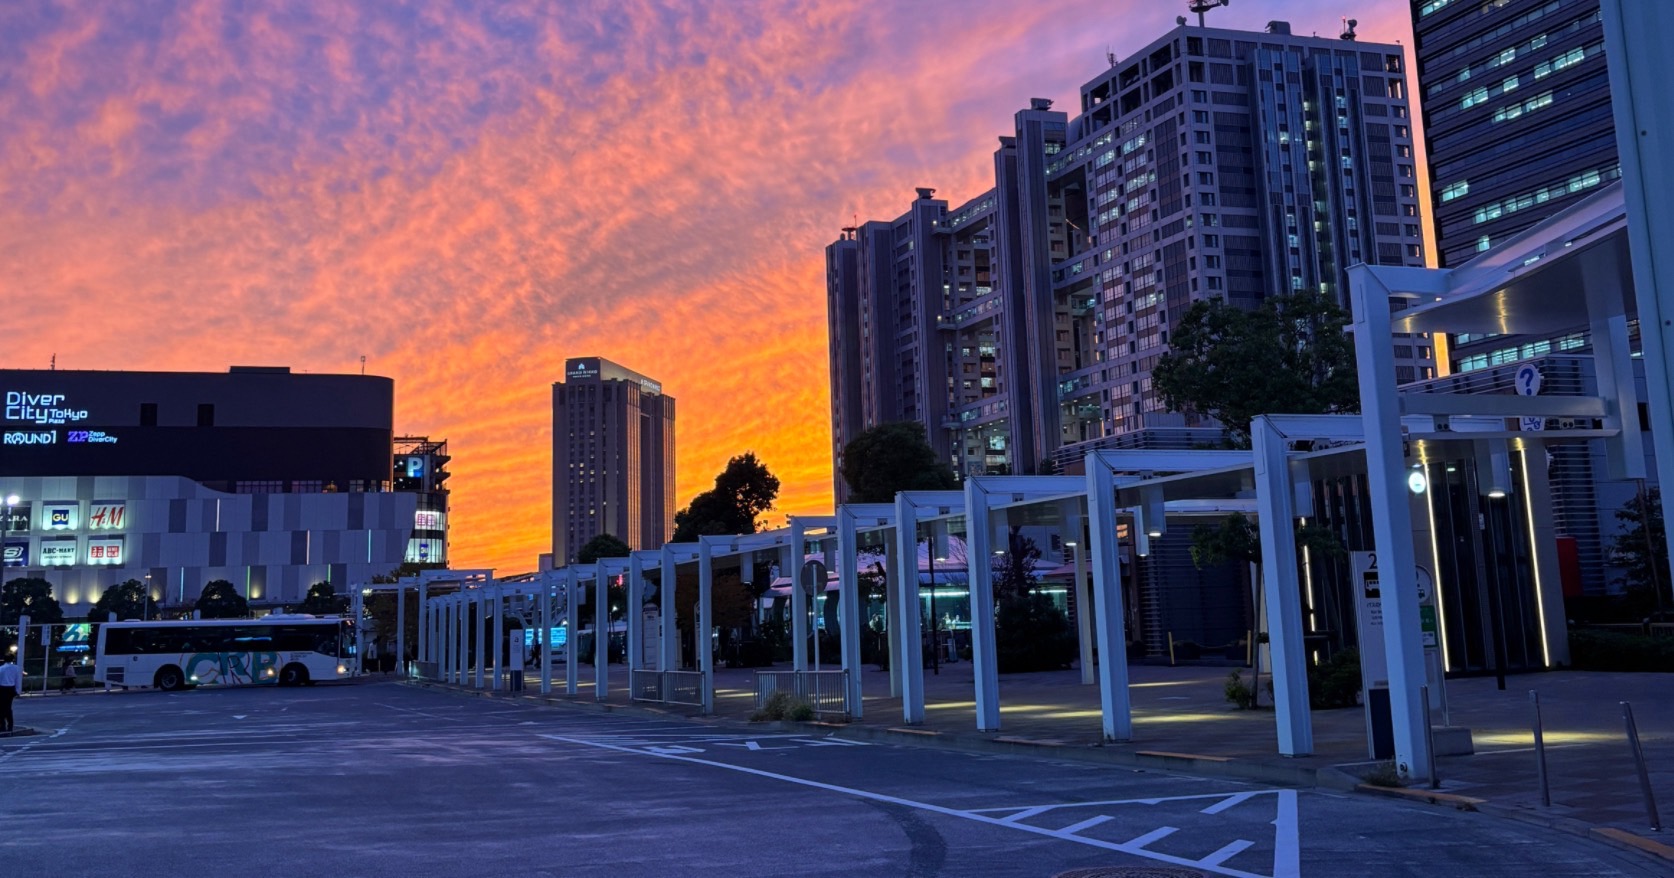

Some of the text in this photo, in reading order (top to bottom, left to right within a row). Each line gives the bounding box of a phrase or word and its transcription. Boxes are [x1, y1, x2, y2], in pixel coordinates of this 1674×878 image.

[6, 391, 65, 406] Diver
[5, 405, 88, 424] City Tokyo
[52, 513, 69, 522] GU
[91, 506, 124, 526] H&M
